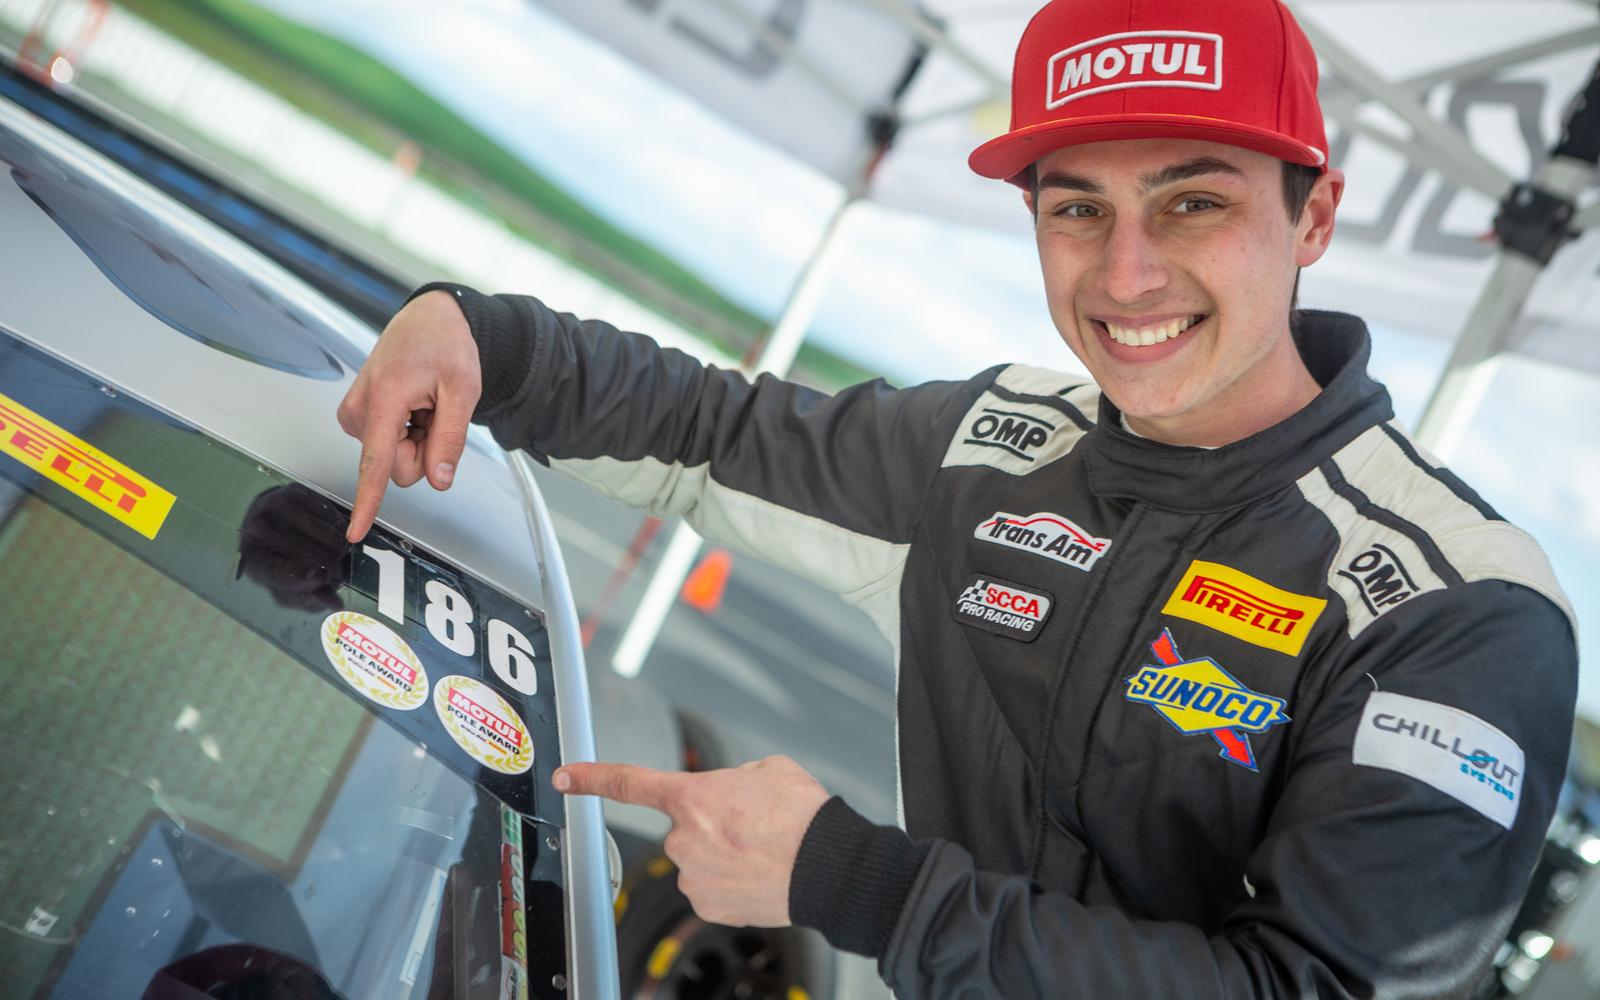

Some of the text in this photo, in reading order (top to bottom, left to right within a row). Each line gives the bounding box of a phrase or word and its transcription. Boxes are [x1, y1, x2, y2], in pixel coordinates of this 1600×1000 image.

[1058, 43, 1207, 94] MOTUL
[0, 404, 147, 514] ELLI
[971, 415, 1048, 451] OMP
[988, 517, 1093, 565] Trans Am
[985, 587, 1040, 618] SCCA
[1349, 550, 1411, 608] OMP
[959, 601, 1036, 632] PRO RACING
[1181, 575, 1305, 636] PIRELLI
[335, 638, 367, 661] POLE
[368, 661, 412, 692] AWARD
[341, 627, 413, 681] MOTUL
[451, 692, 517, 744] MOTUL
[1131, 670, 1272, 727] SUNOCO
[447, 704, 476, 726] POLE
[478, 726, 520, 755] AWARD
[1372, 713, 1519, 787] CHILLOUT
[1460, 763, 1515, 801] SYSTEMS
